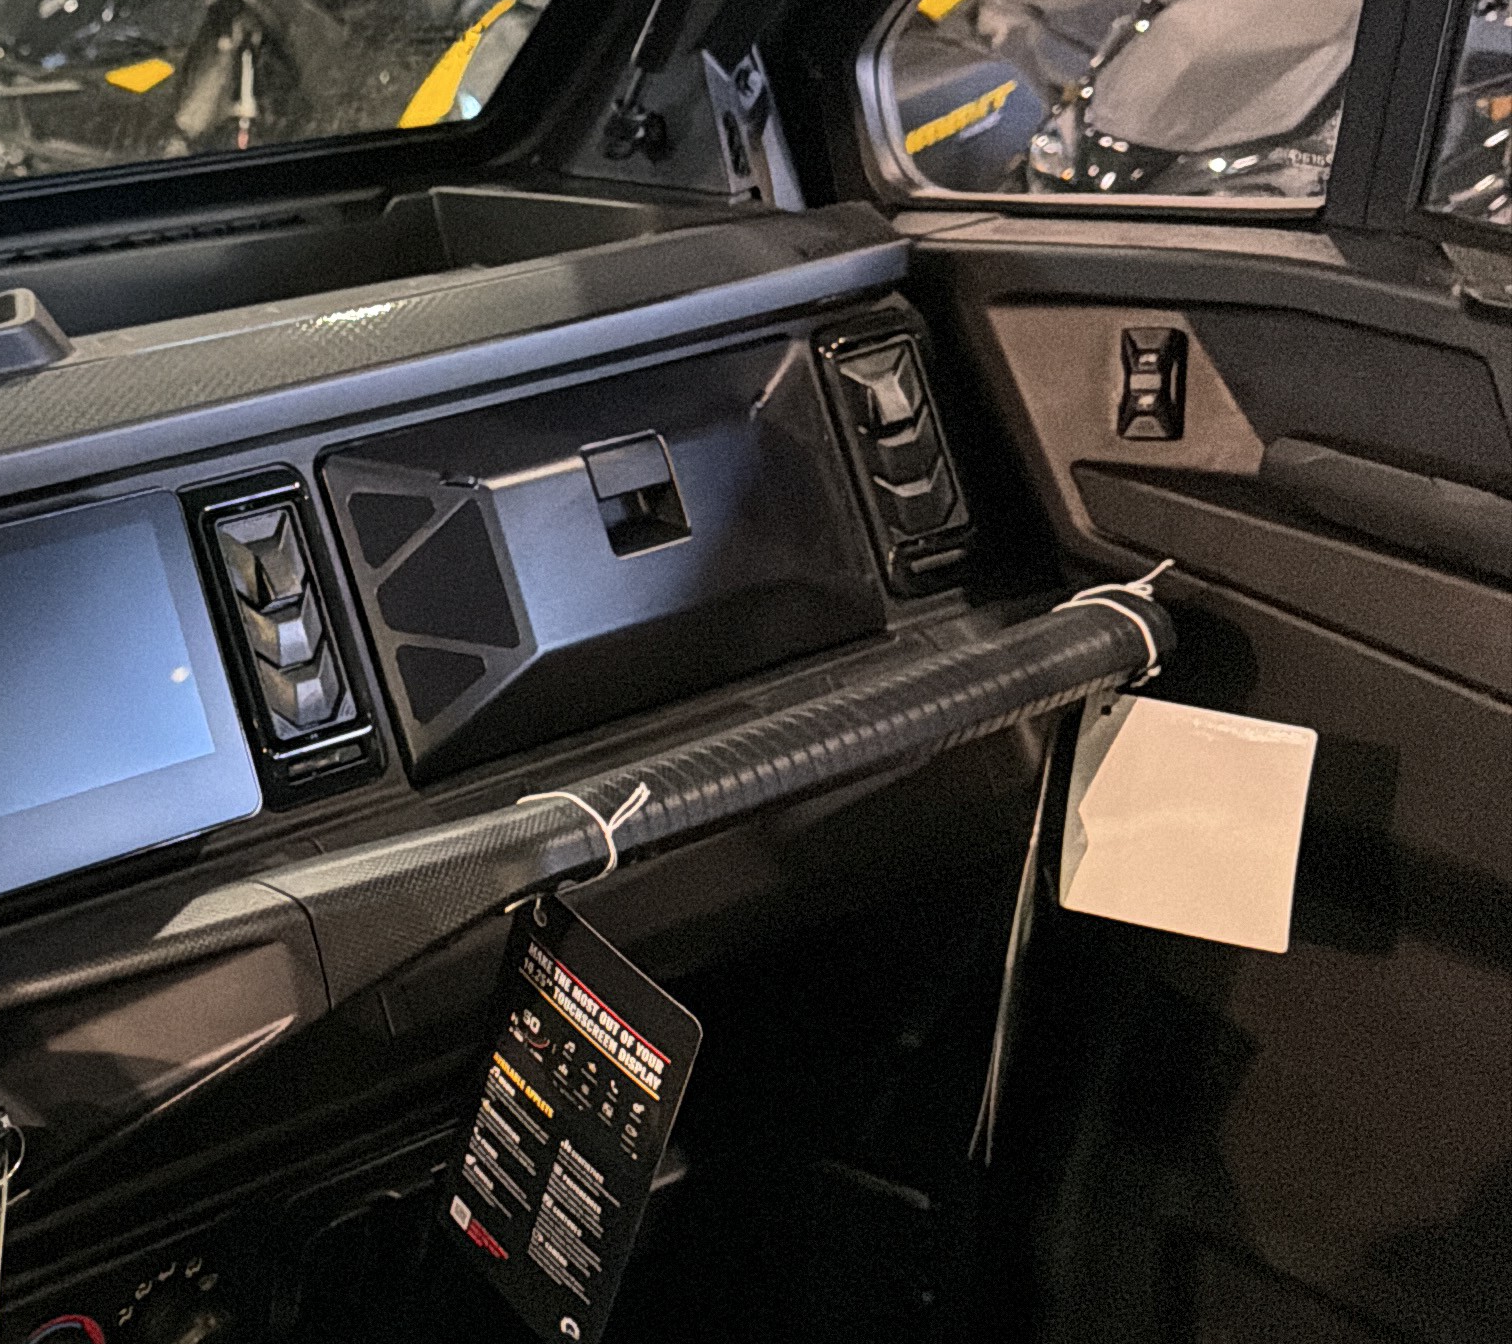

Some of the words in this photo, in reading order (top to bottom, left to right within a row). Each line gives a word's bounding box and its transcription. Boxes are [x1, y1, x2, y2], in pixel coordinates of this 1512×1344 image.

[528, 942, 554, 975] MAKE
[554, 967, 573, 993] THE
[572, 984, 601, 1017] MOST
[598, 1009, 621, 1036] OUT
[620, 1028, 637, 1049] OF
[635, 1041, 666, 1075] YOUR
[553, 986, 619, 1055] TOUCHSCREEN
[617, 1048, 663, 1091] DISPLAY
